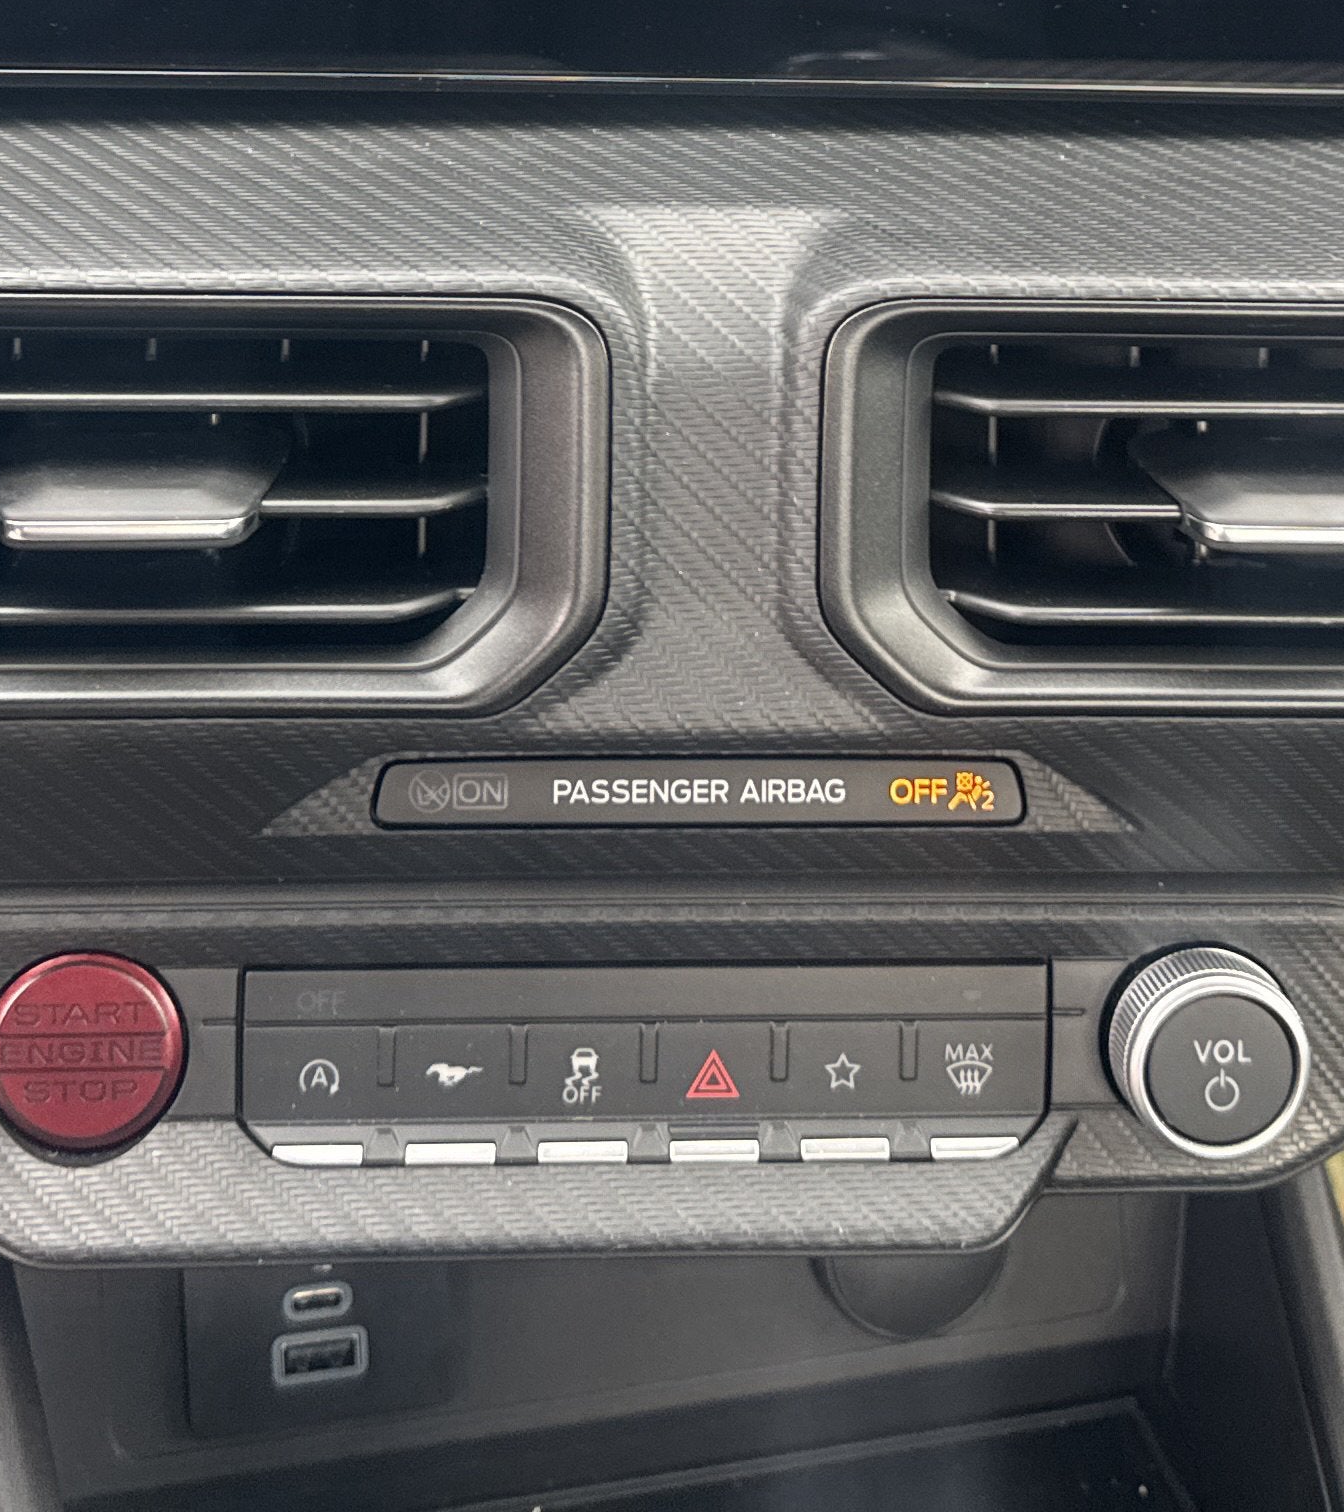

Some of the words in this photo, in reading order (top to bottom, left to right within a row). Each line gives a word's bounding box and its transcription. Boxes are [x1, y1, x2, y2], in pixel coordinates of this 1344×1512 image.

[457, 779, 504, 804] ON
[552, 778, 730, 806] PASSENGER
[739, 777, 847, 805] AIRBAG
[888, 777, 949, 806] OFF
[14, 1000, 149, 1027] START
[297, 990, 347, 1016] OFF
[0, 1038, 163, 1065] ENGINE
[944, 1042, 994, 1063] MAX
[1192, 1038, 1252, 1065] VOL
[23, 1078, 139, 1104] STOP
[561, 1085, 603, 1105] OFF
